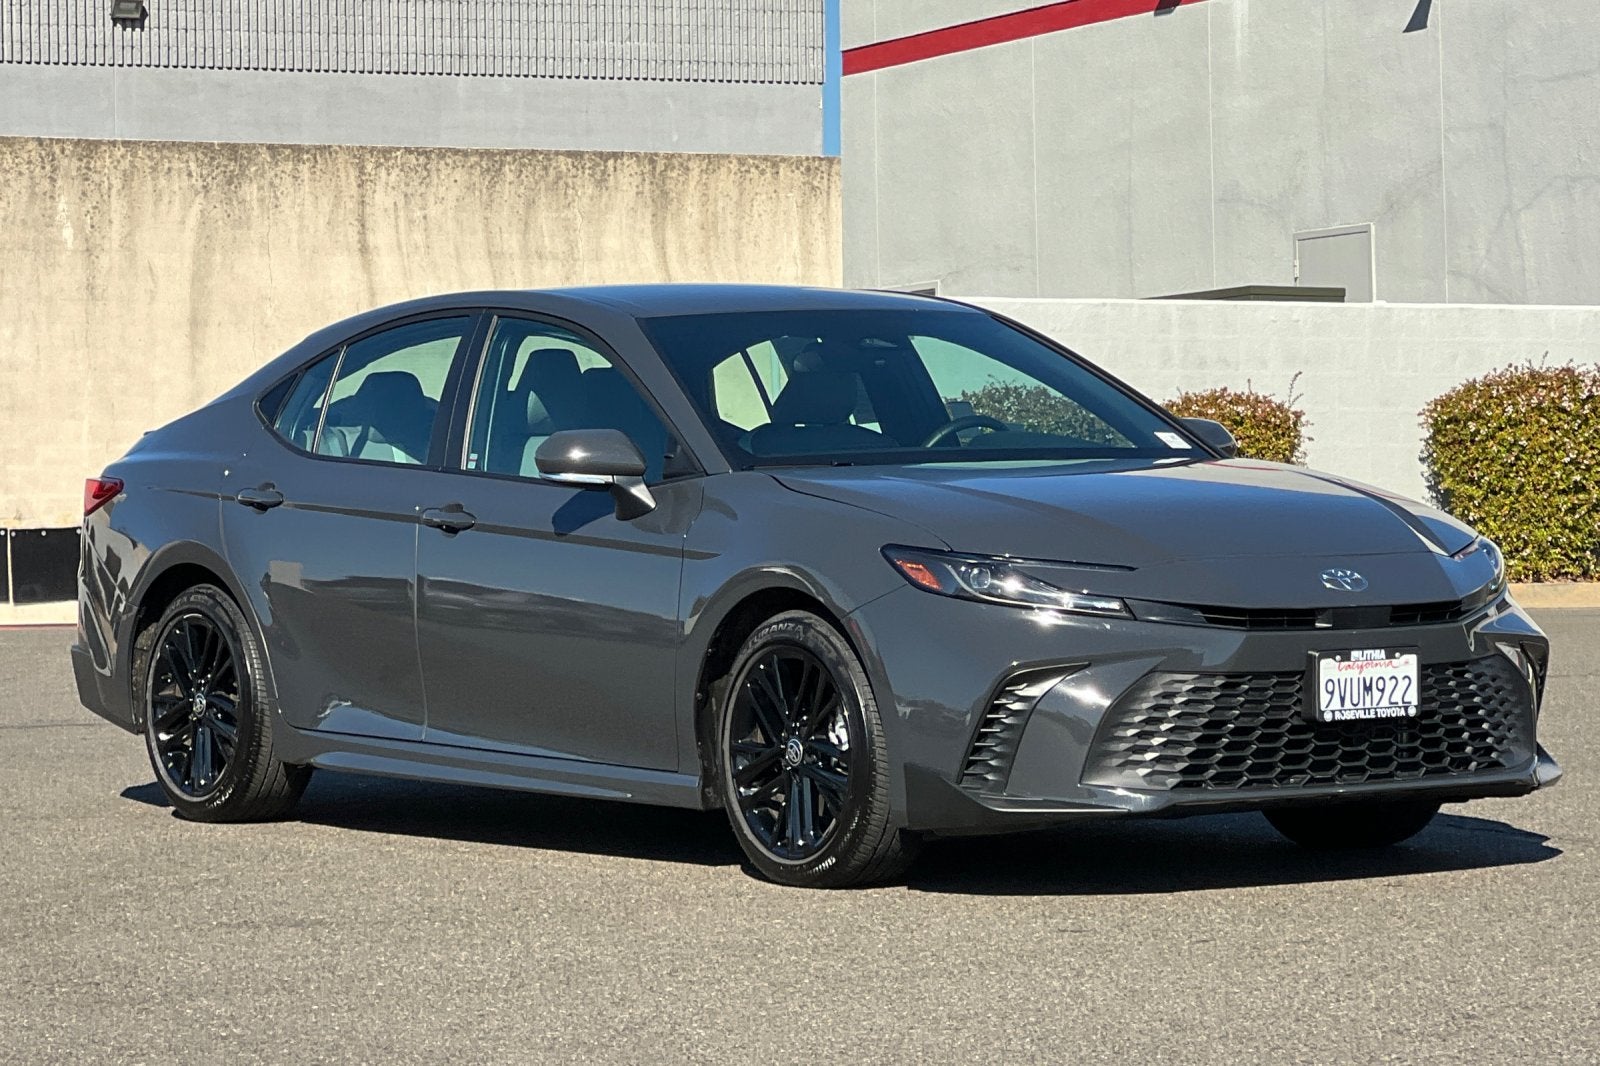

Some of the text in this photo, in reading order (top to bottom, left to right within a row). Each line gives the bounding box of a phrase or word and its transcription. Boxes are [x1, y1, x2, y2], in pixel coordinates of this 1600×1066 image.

[1338, 660, 1399, 674] California
[1325, 675, 1412, 708] 9VUM922
[1334, 707, 1405, 720] ROSEVILLE TOYOTA
